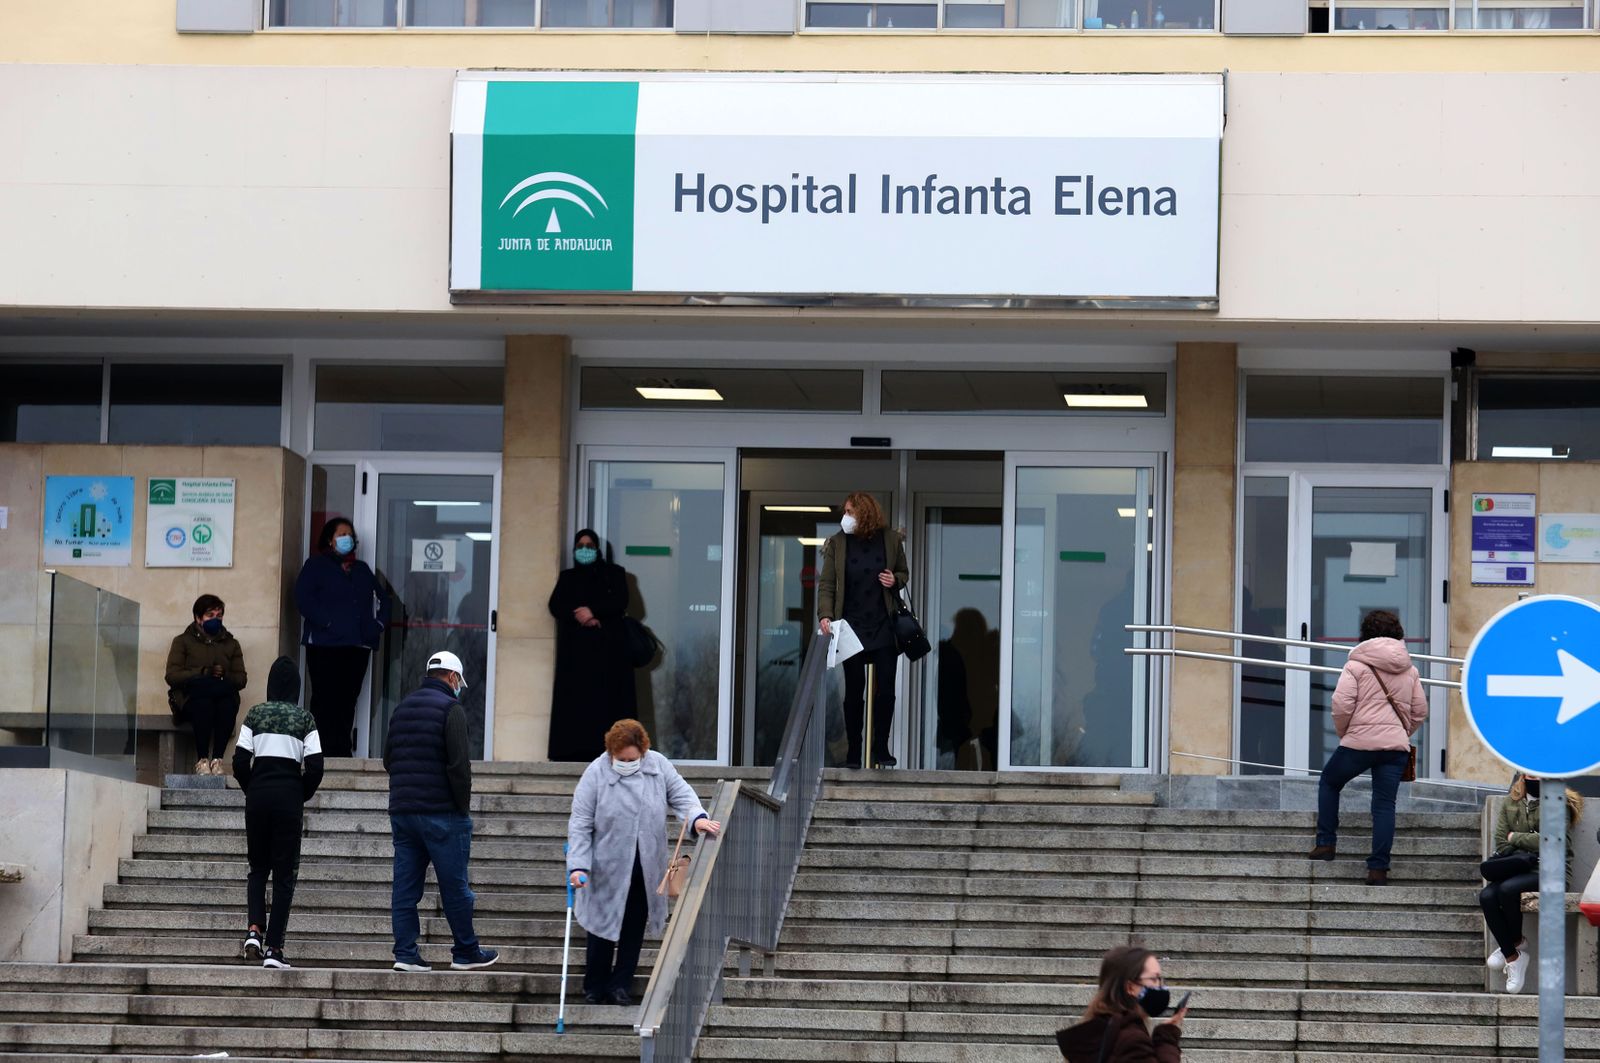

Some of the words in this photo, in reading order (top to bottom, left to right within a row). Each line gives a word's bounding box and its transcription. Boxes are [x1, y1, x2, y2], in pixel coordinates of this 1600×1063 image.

[674, 172, 857, 224] Hospital
[881, 173, 1032, 215] Infanta
[1054, 175, 1178, 217] Elena
[497, 238, 532, 251] JUNTA
[536, 238, 550, 251] DE
